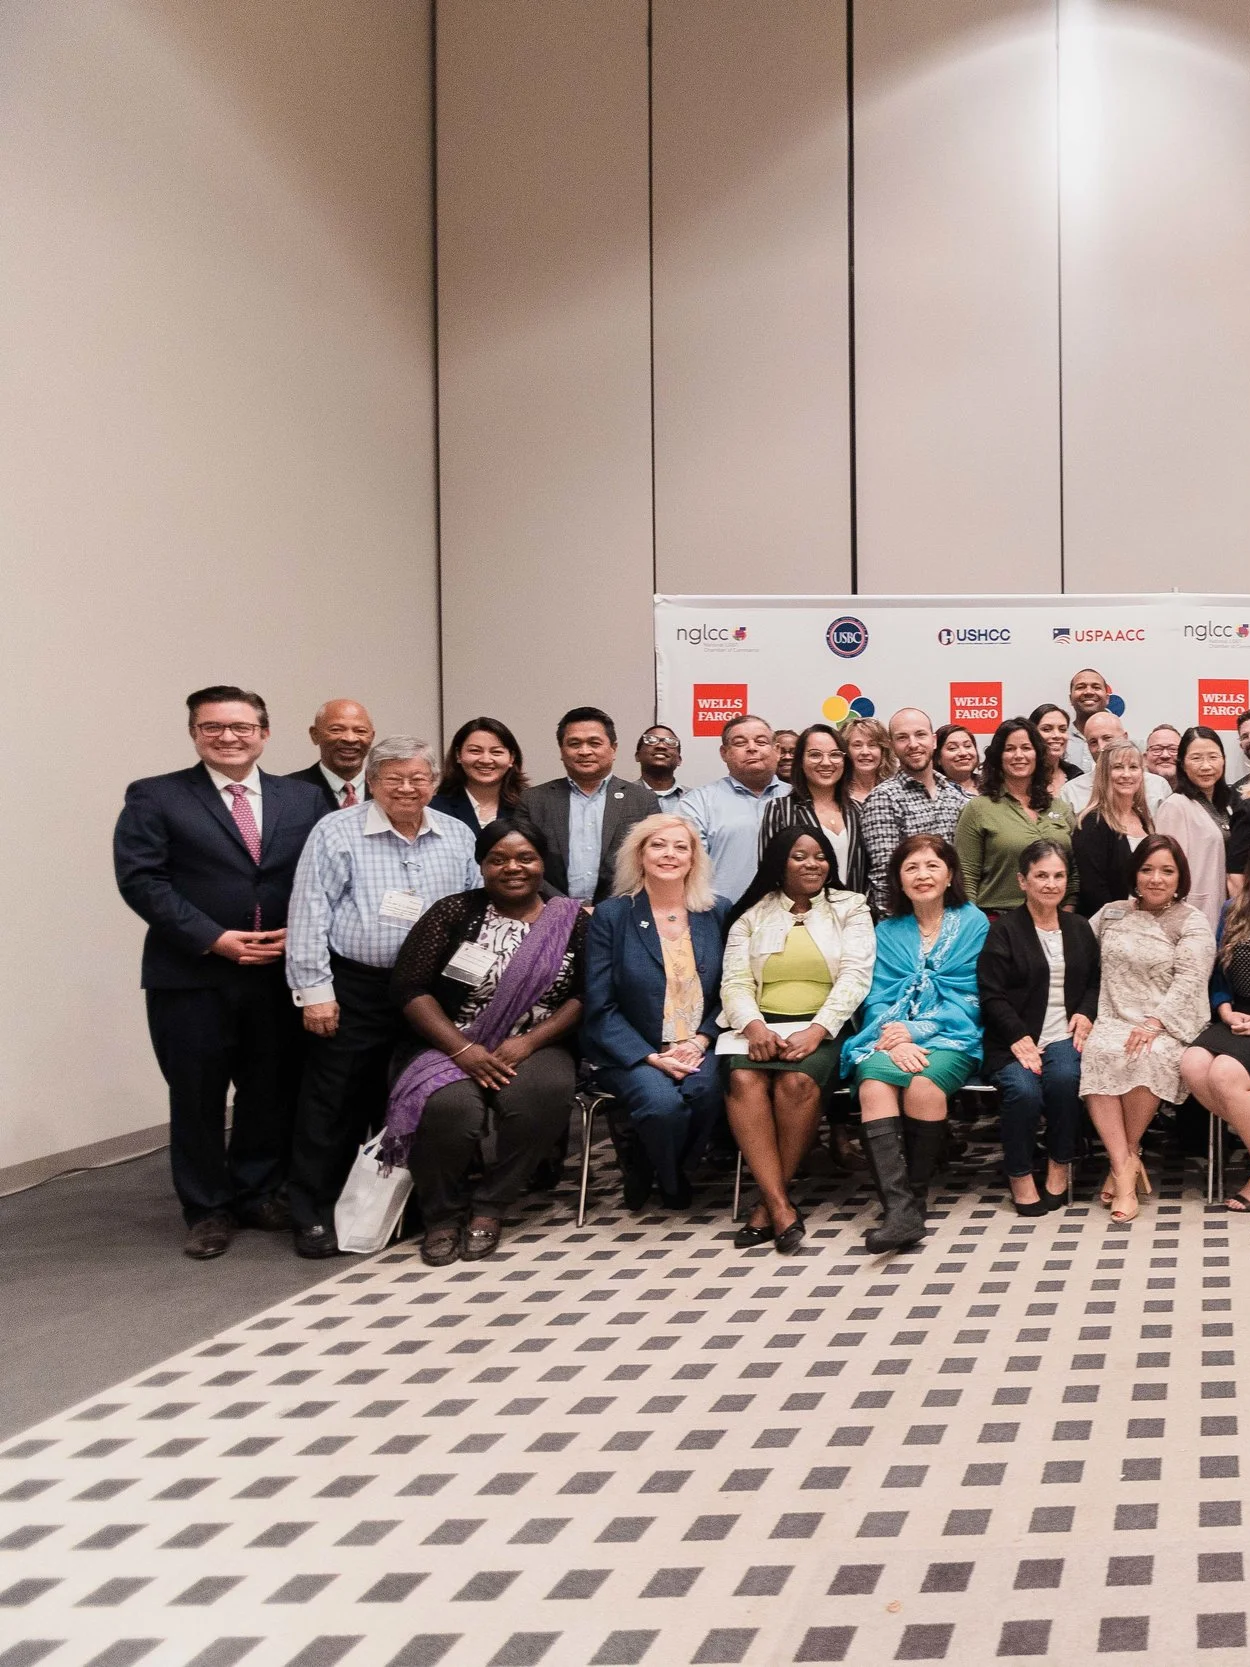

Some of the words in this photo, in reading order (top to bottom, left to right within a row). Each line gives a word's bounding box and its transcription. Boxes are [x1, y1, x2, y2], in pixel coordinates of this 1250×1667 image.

[676, 623, 729, 645] nglcc
[956, 628, 1011, 642] USHCC
[1075, 628, 1146, 642] USPAACC
[1183, 620, 1233, 641] nglcc
[833, 631, 862, 644] USBC
[697, 698, 743, 709] WELLS
[953, 696, 999, 707] WELLS
[1201, 693, 1246, 704] WELLS
[955, 709, 999, 719] FARGO
[1202, 705, 1246, 716] FARGO
